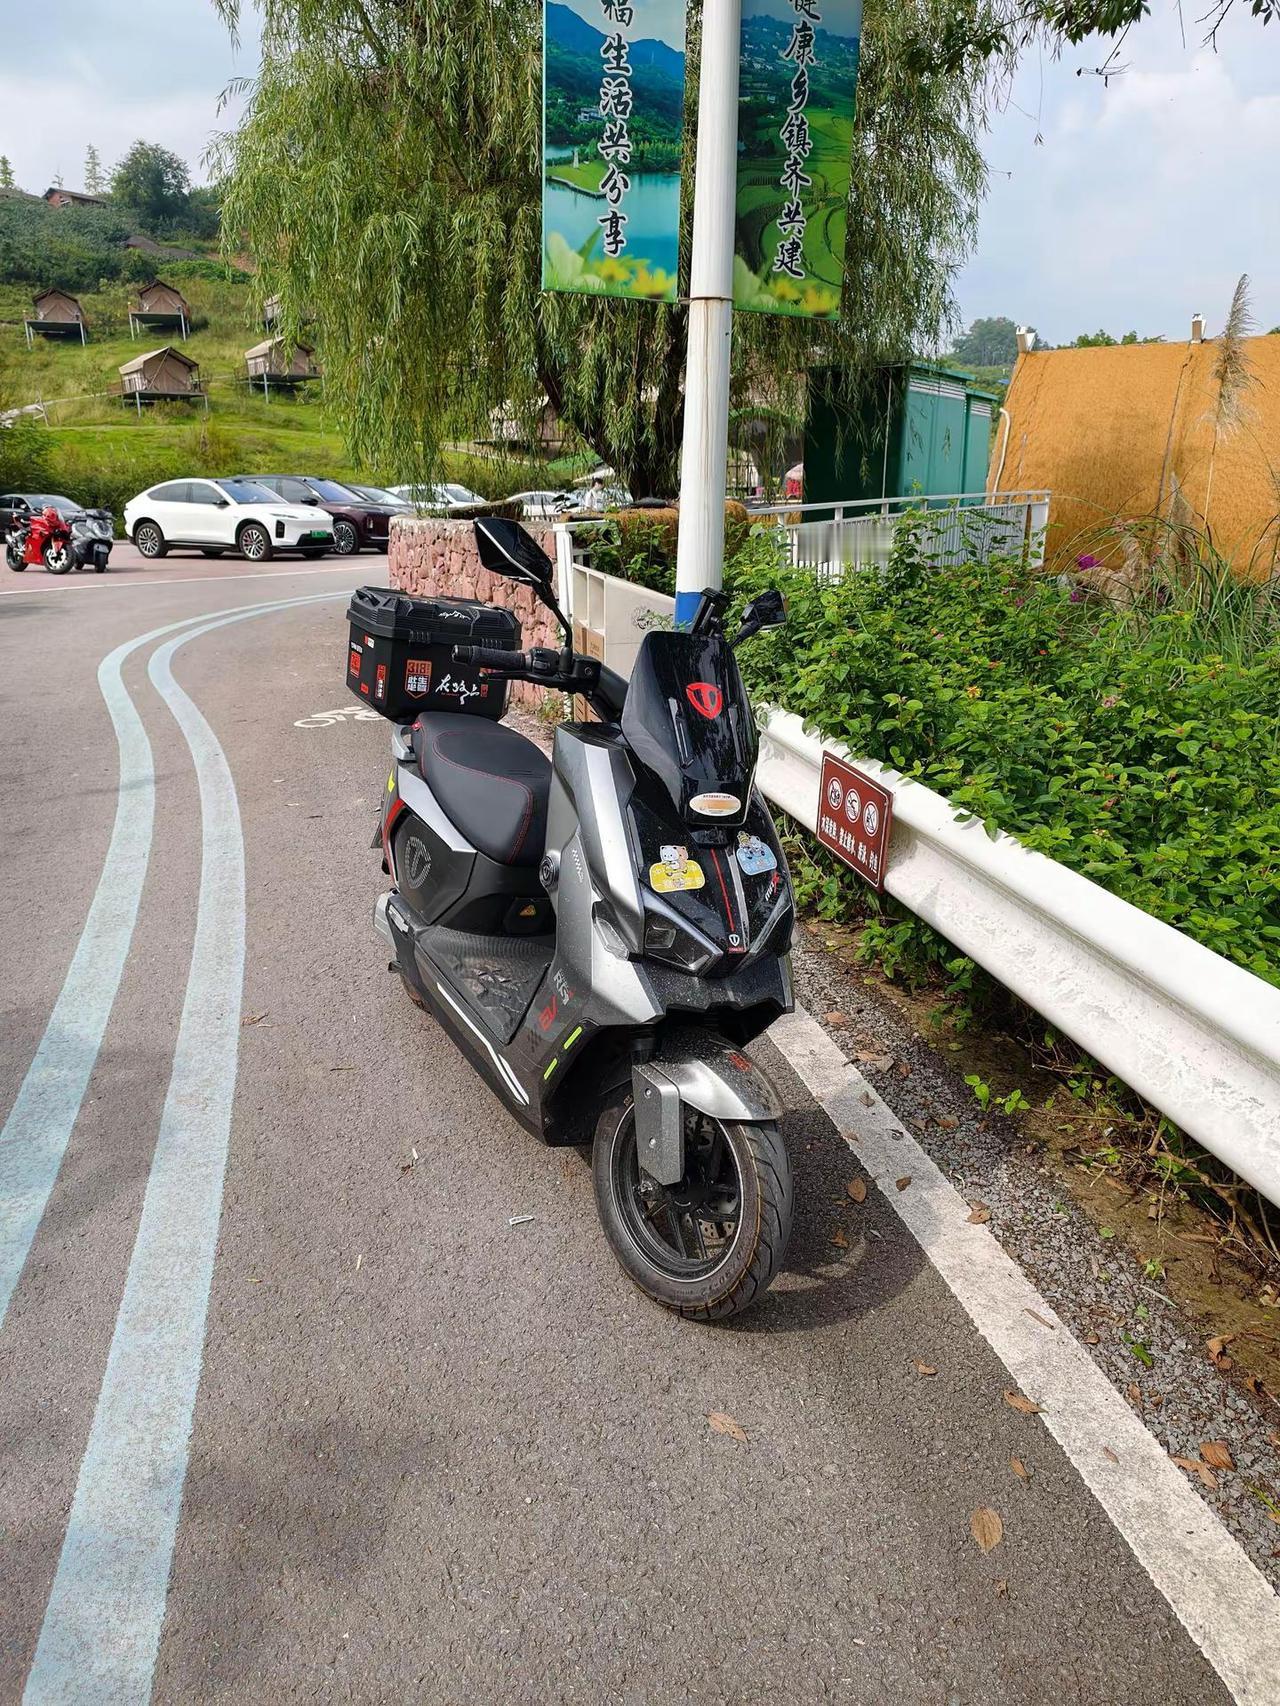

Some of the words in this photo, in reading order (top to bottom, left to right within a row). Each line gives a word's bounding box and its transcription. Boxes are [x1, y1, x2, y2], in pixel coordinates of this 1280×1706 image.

[599, 0, 634, 256] 福生活共分享
[407, 661, 427, 674] 318
